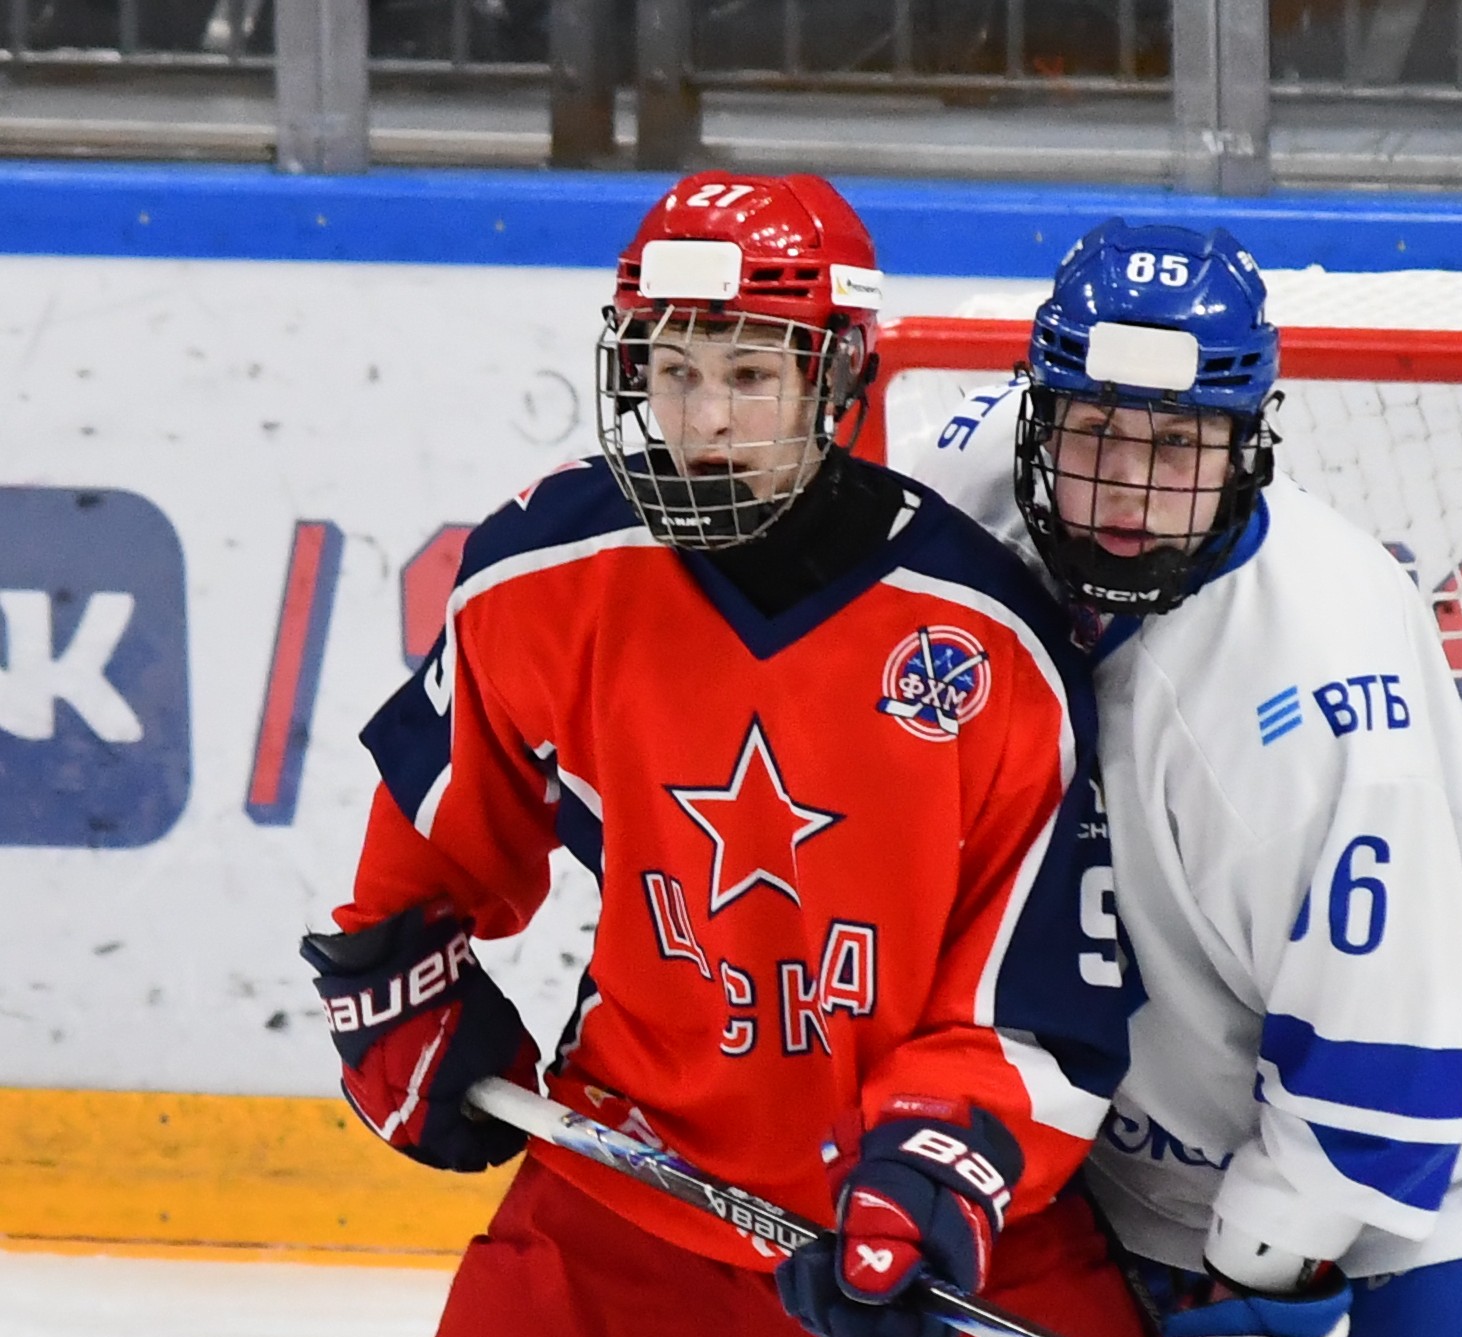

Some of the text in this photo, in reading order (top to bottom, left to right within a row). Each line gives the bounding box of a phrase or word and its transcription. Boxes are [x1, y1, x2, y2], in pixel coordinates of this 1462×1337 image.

[686, 183, 755, 208] 27
[1125, 252, 1190, 288] 85
[1082, 581, 1164, 604] CCM
[1312, 674, 1411, 739] ВТБ
